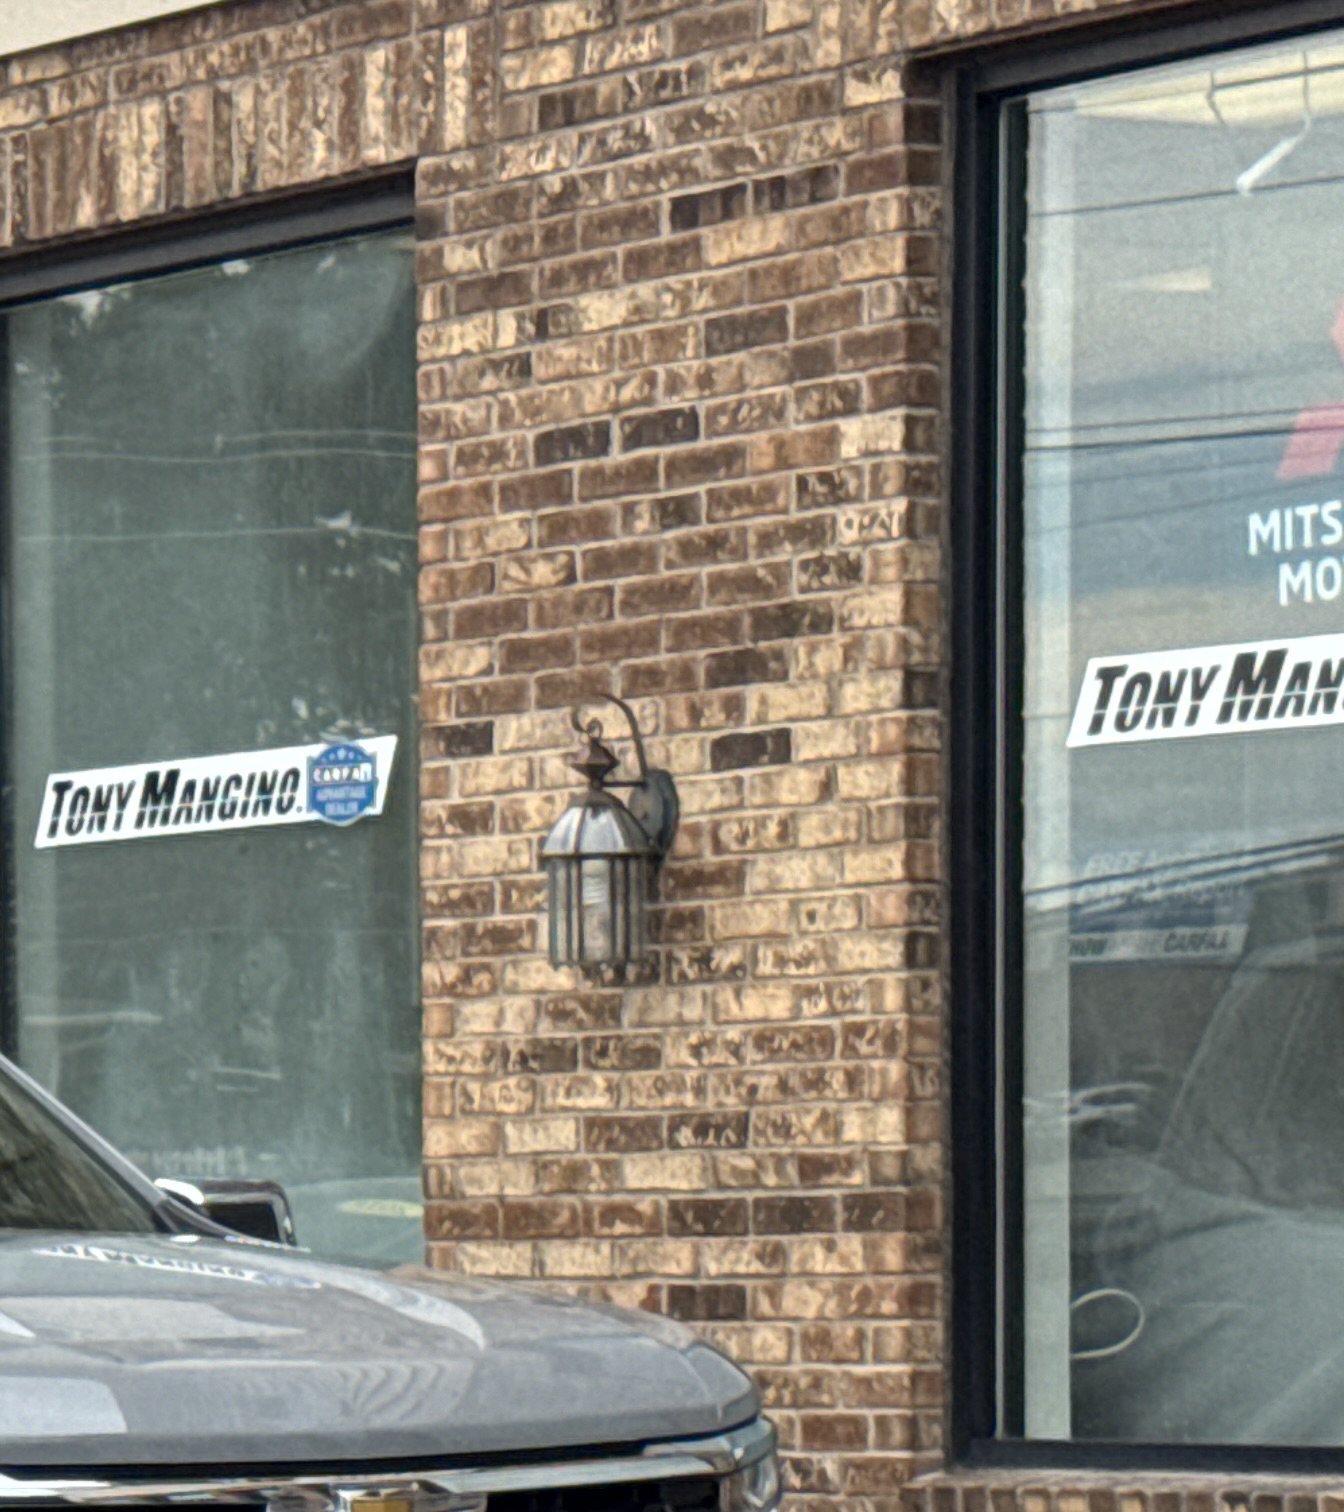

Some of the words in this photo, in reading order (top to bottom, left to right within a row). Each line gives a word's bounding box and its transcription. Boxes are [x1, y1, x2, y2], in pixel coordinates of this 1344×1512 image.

[1087, 664, 1221, 736] TONY
[47, 780, 135, 839] TONY
[133, 768, 302, 830] MANGINO
